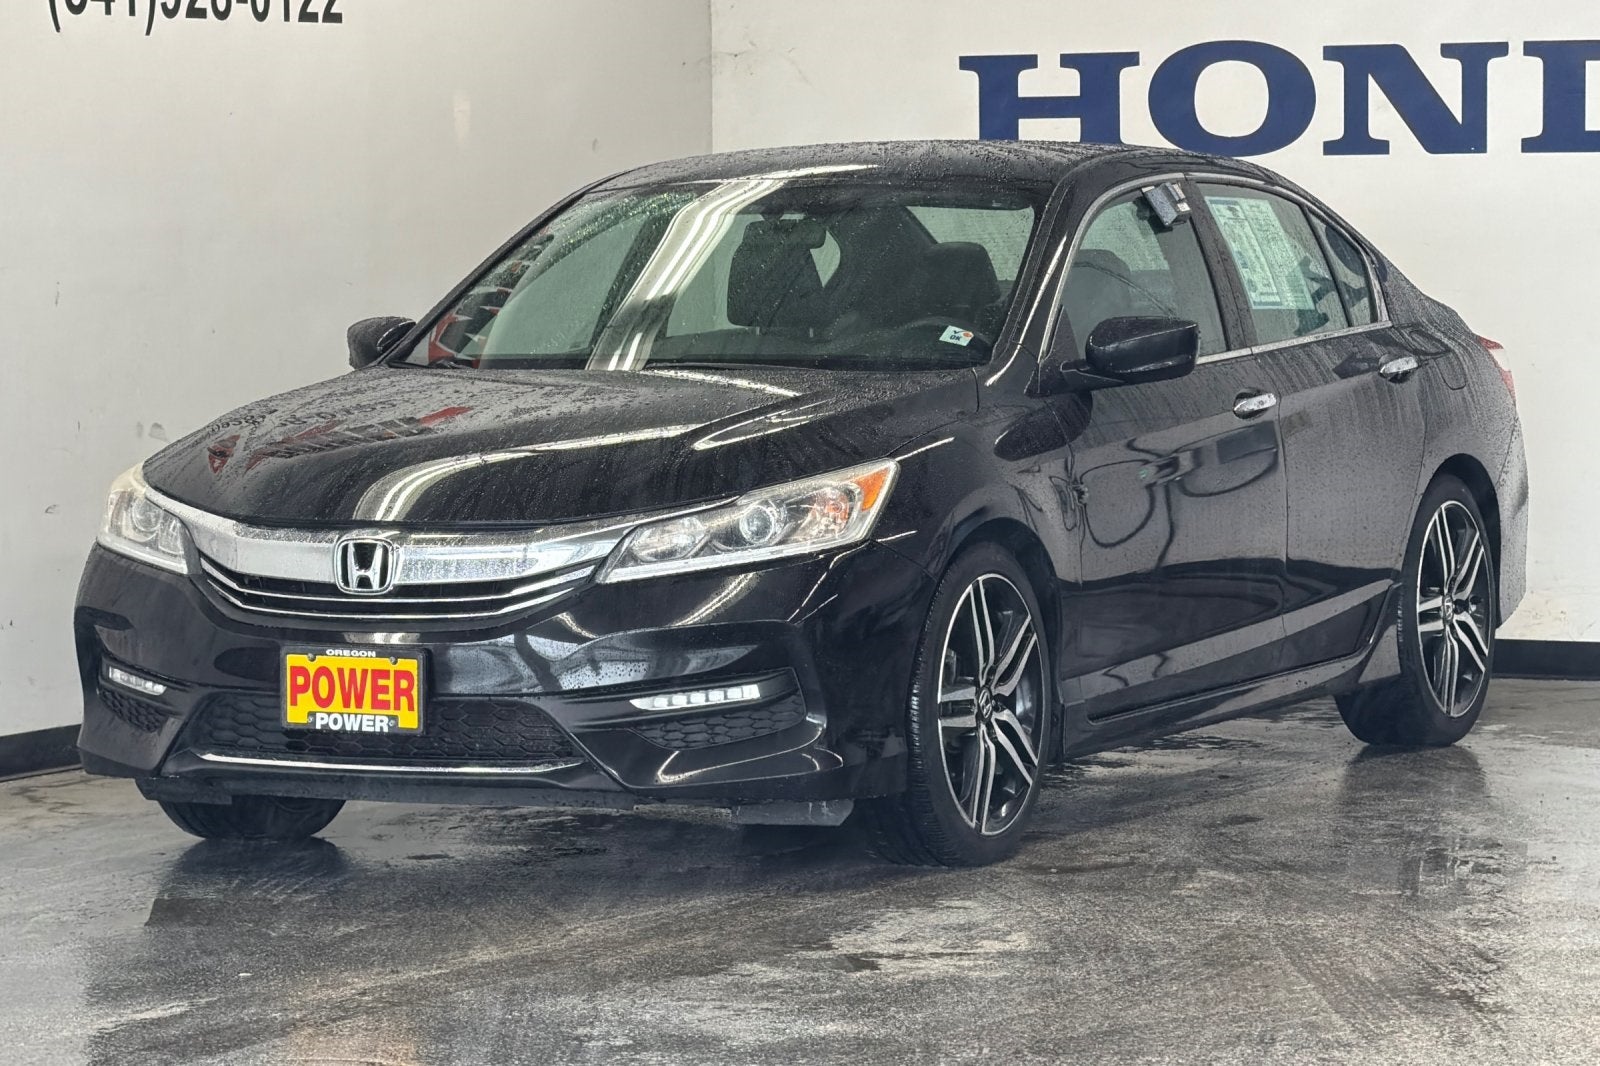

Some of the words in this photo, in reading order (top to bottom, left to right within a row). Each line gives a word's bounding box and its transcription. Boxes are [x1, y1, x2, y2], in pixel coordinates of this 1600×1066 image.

[325, 649, 376, 658] OREGON
[290, 665, 415, 712] POWER
[315, 712, 389, 733] POWER
